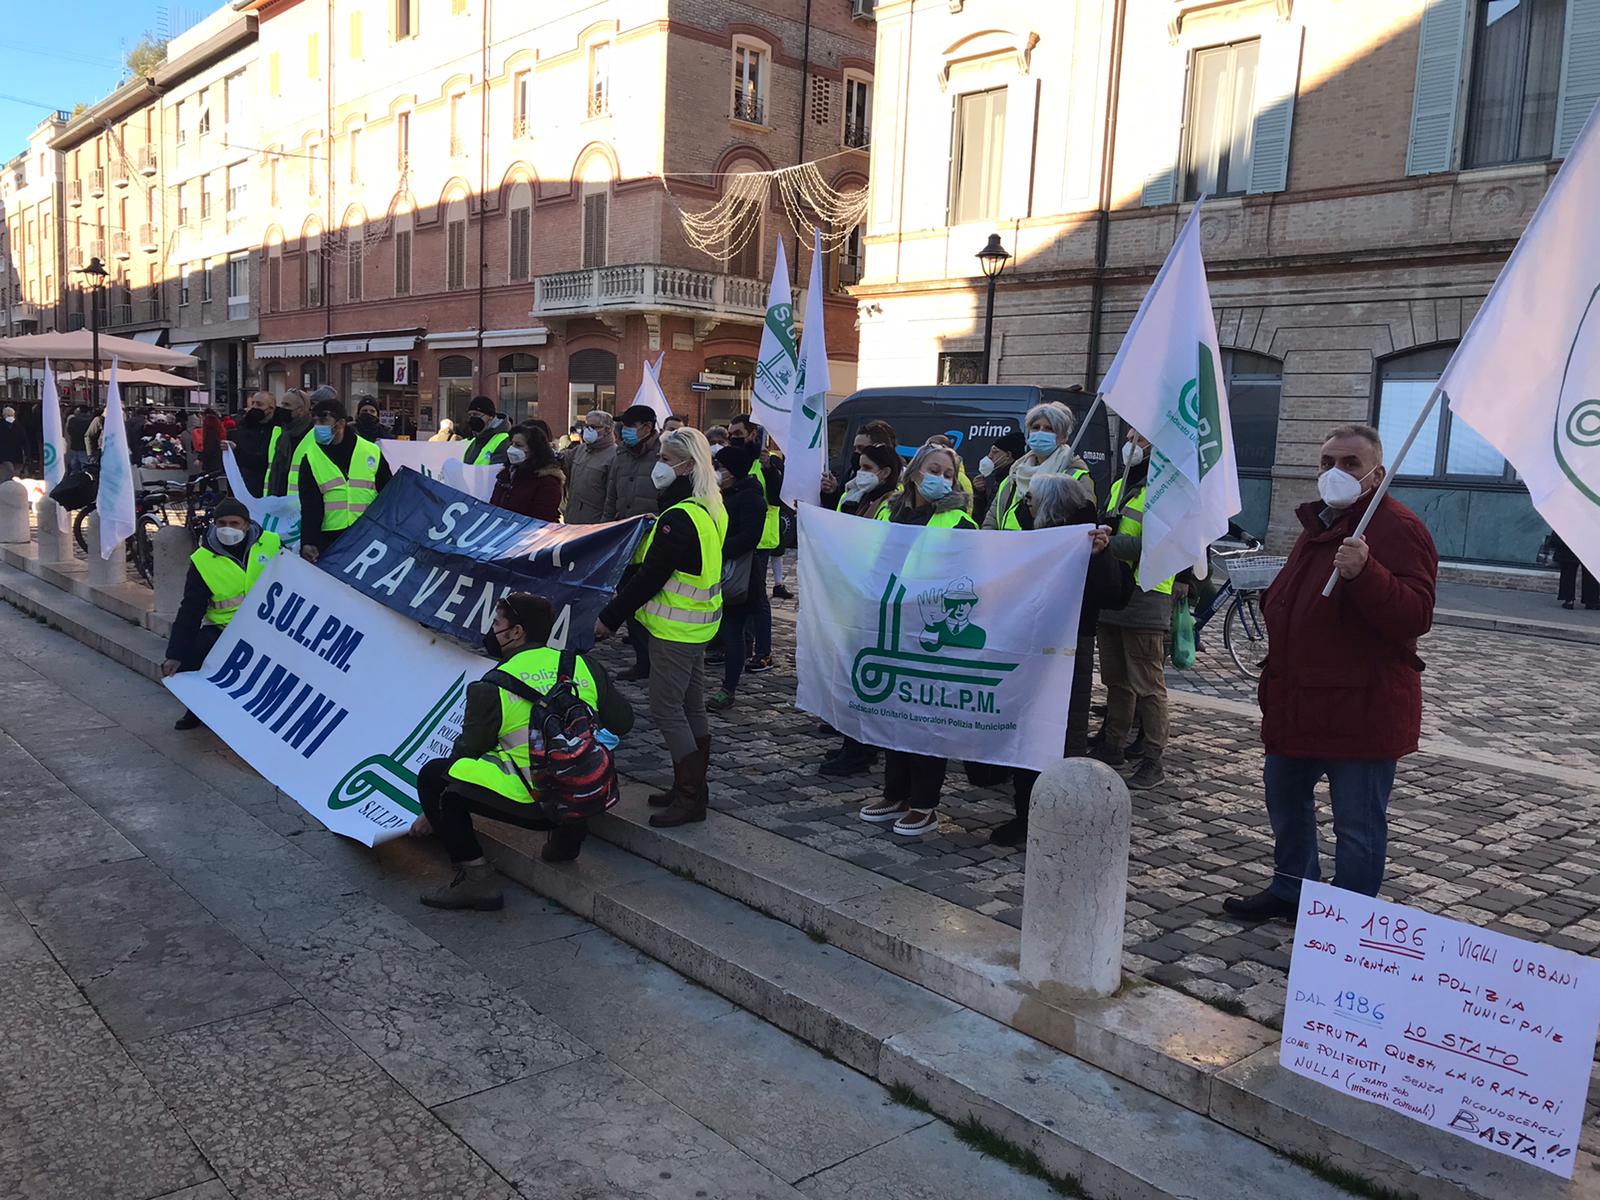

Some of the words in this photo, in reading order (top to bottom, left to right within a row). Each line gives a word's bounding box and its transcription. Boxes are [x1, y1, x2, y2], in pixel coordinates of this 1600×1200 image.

[968, 421, 1011, 440] prime
[1083, 450, 1105, 460] amazon
[343, 539, 571, 650] RAVENA
[257, 581, 364, 673] S.U.L.P.M.
[206, 638, 349, 759] RIMINI
[899, 680, 1001, 714] S.U.L.P.M.
[848, 701, 879, 715] Sindacato
[880, 708, 908, 720] Unitario
[910, 713, 947, 725] Lavoratori
[948, 718, 973, 729] Polizia
[975, 721, 1017, 732] Municipale
[1307, 900, 1348, 924] DAL
[1361, 912, 1427, 946] 1986
[1458, 936, 1497, 964] VIGILI
[1513, 958, 1578, 989] URBANI
[1304, 939, 1337, 955] SONO
[1438, 973, 1525, 1012] POLIZIA
[1295, 990, 1326, 1007] DAL
[1333, 991, 1385, 1020] 1986
[1404, 1022, 1427, 1038] LO
[1441, 1033, 1519, 1066] STATO
[1303, 1020, 1368, 1048] SFRUTTA
[1294, 1056, 1340, 1081] NULLA
[1402, 1075, 1444, 1095] SENZA
